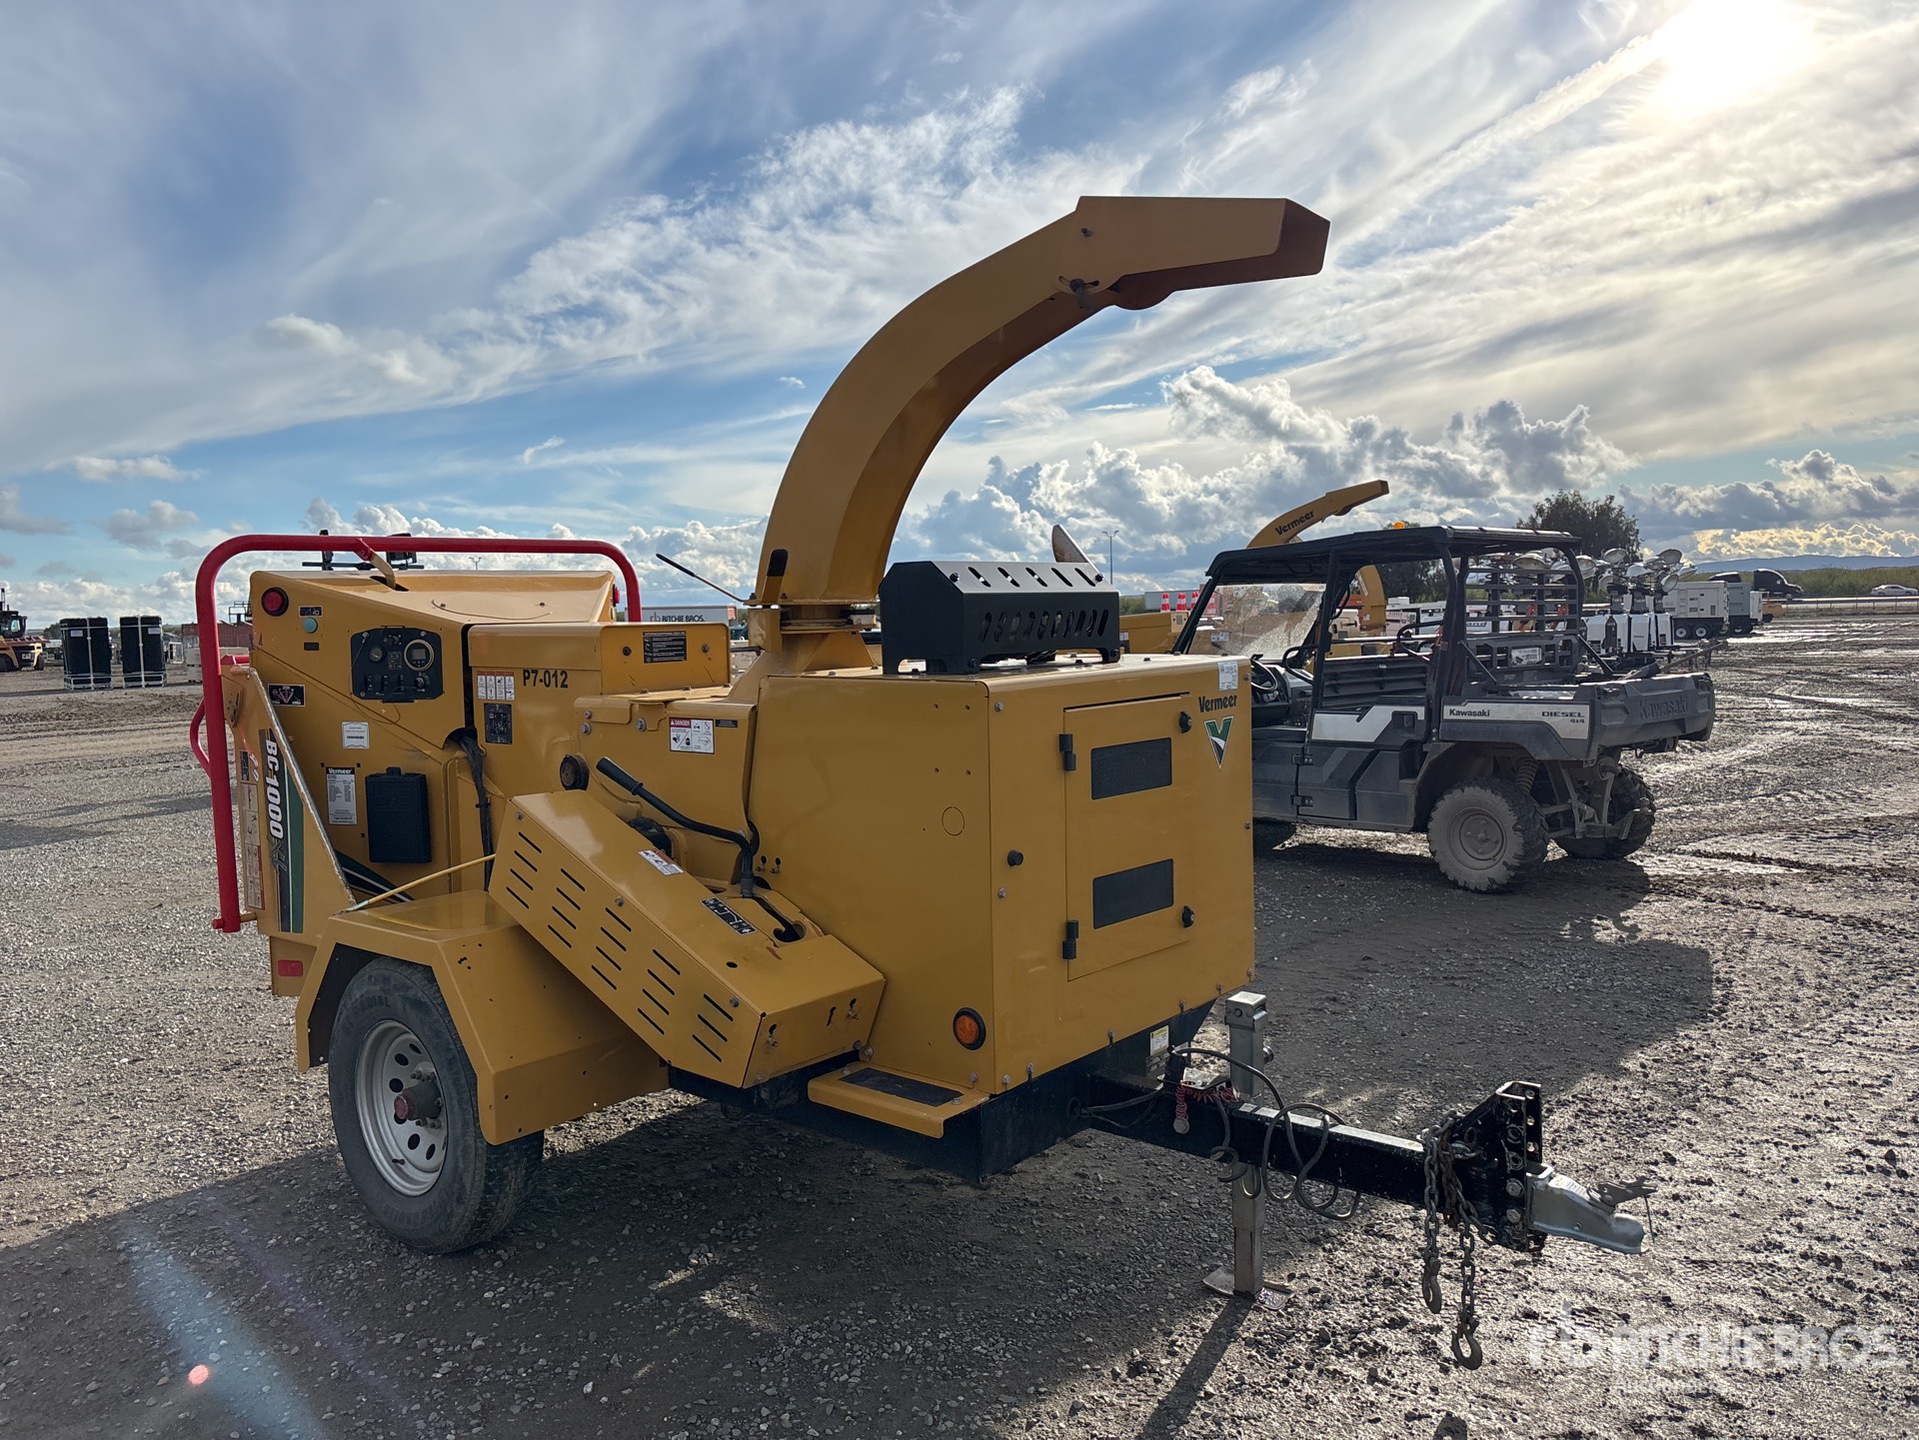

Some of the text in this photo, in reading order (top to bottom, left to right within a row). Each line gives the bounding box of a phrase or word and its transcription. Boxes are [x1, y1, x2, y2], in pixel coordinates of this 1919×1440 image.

[1275, 510, 1315, 536] Vermeer
[662, 614, 684, 622] RITCHIE
[522, 669, 569, 688] P7-012
[1198, 694, 1238, 713] Vermeer
[1449, 708, 1490, 718] Kawasaki
[328, 767, 353, 775] Vermeer
